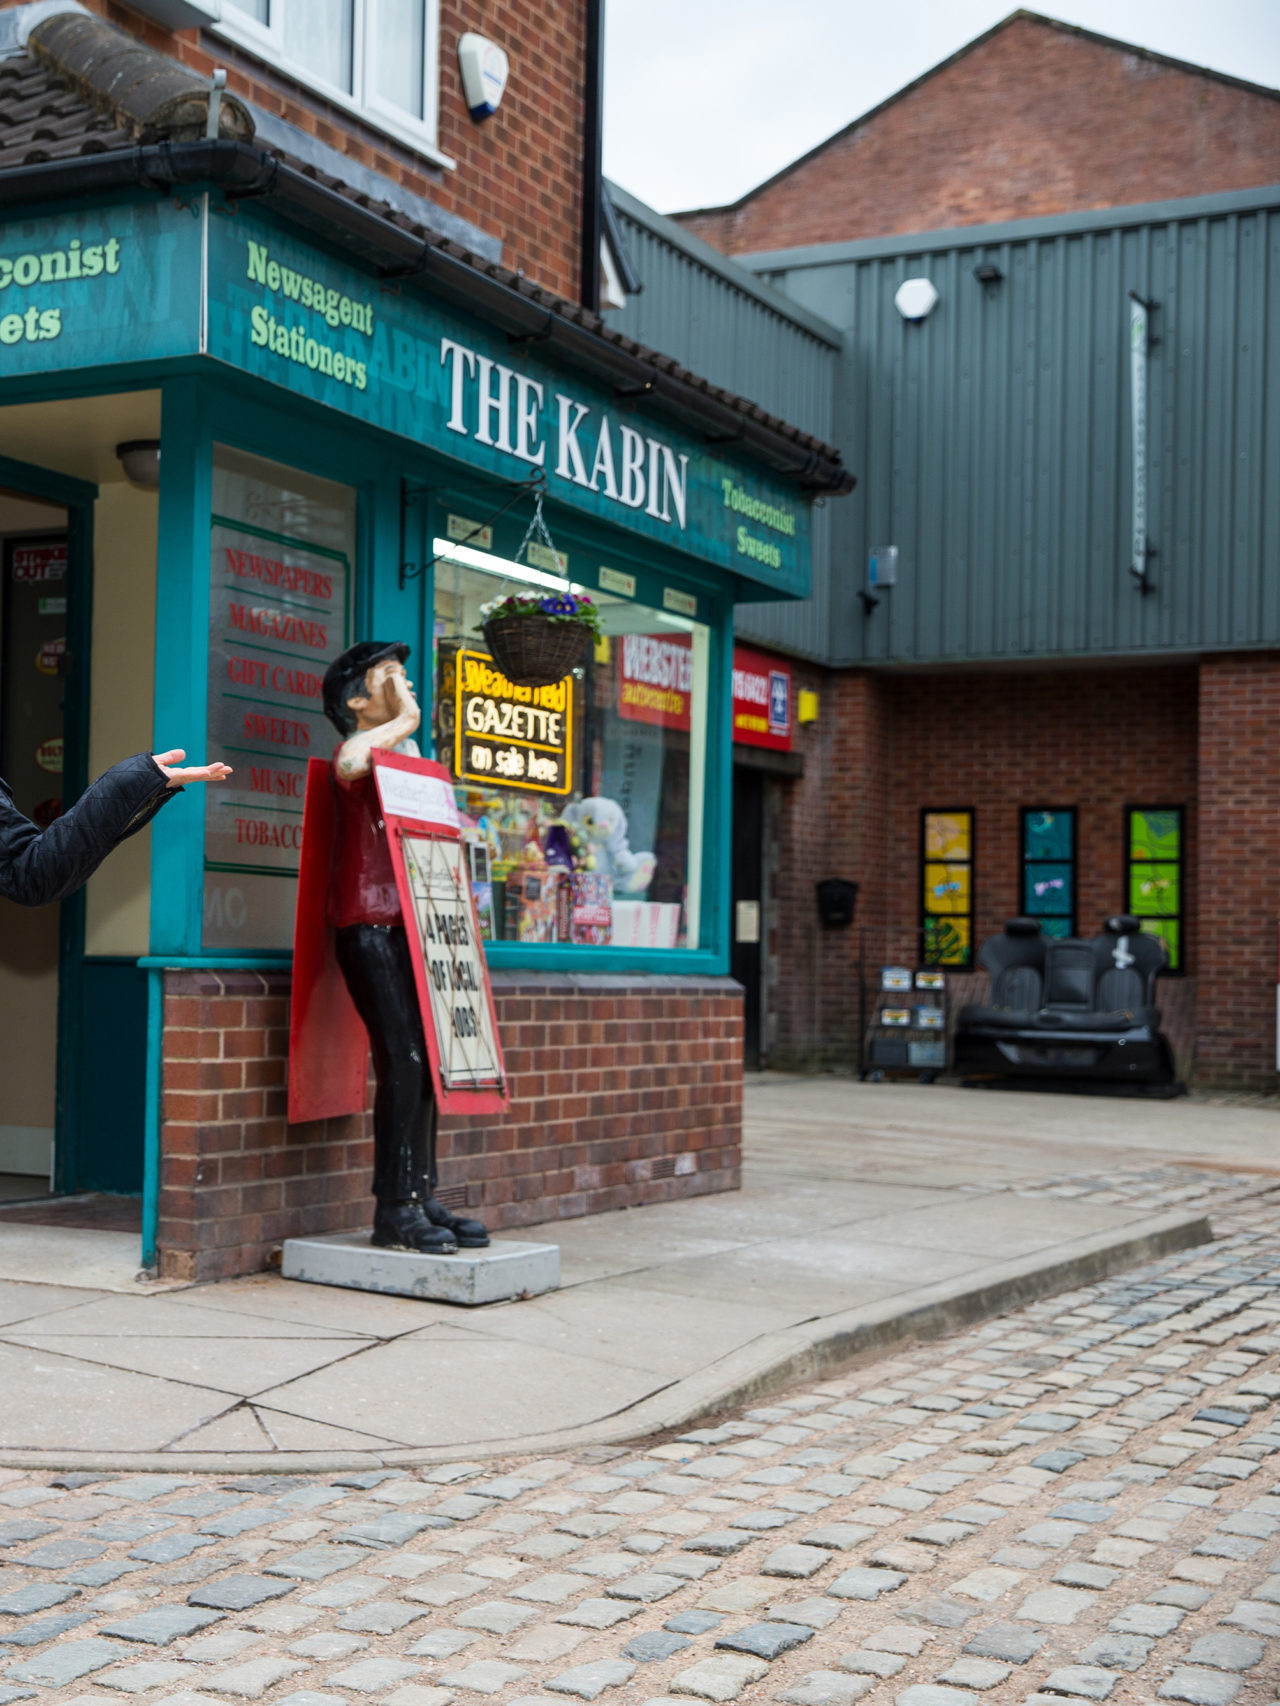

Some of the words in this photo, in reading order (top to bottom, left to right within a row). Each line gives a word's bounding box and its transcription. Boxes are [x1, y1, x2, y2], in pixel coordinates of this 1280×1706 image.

[247, 240, 374, 336] Newsagent
[251, 304, 368, 391] Stationers
[440, 337, 546, 467] THE
[554, 393, 689, 530] KABIN
[722, 477, 795, 536] Tobacconist
[737, 525, 781, 569] Sweets
[225, 547, 333, 600] NEWSPAPERS
[229, 602, 329, 650] MAGAZINES
[228, 655, 269, 688] GIFT
[623, 633, 692, 692] WEBSTE
[243, 712, 311, 748] SWEETS
[466, 696, 562, 746] GAZETTE
[250, 766, 303, 799] MUSIC
[471, 744, 493, 771] on
[495, 746, 525, 777] sale
[527, 749, 559, 783] here
[234, 818, 303, 850] TOBACC
[426, 913, 436, 945] 4
[434, 913, 470, 946] PAGES
[432, 960, 448, 991] OF
[446, 960, 479, 992] LOCAL
